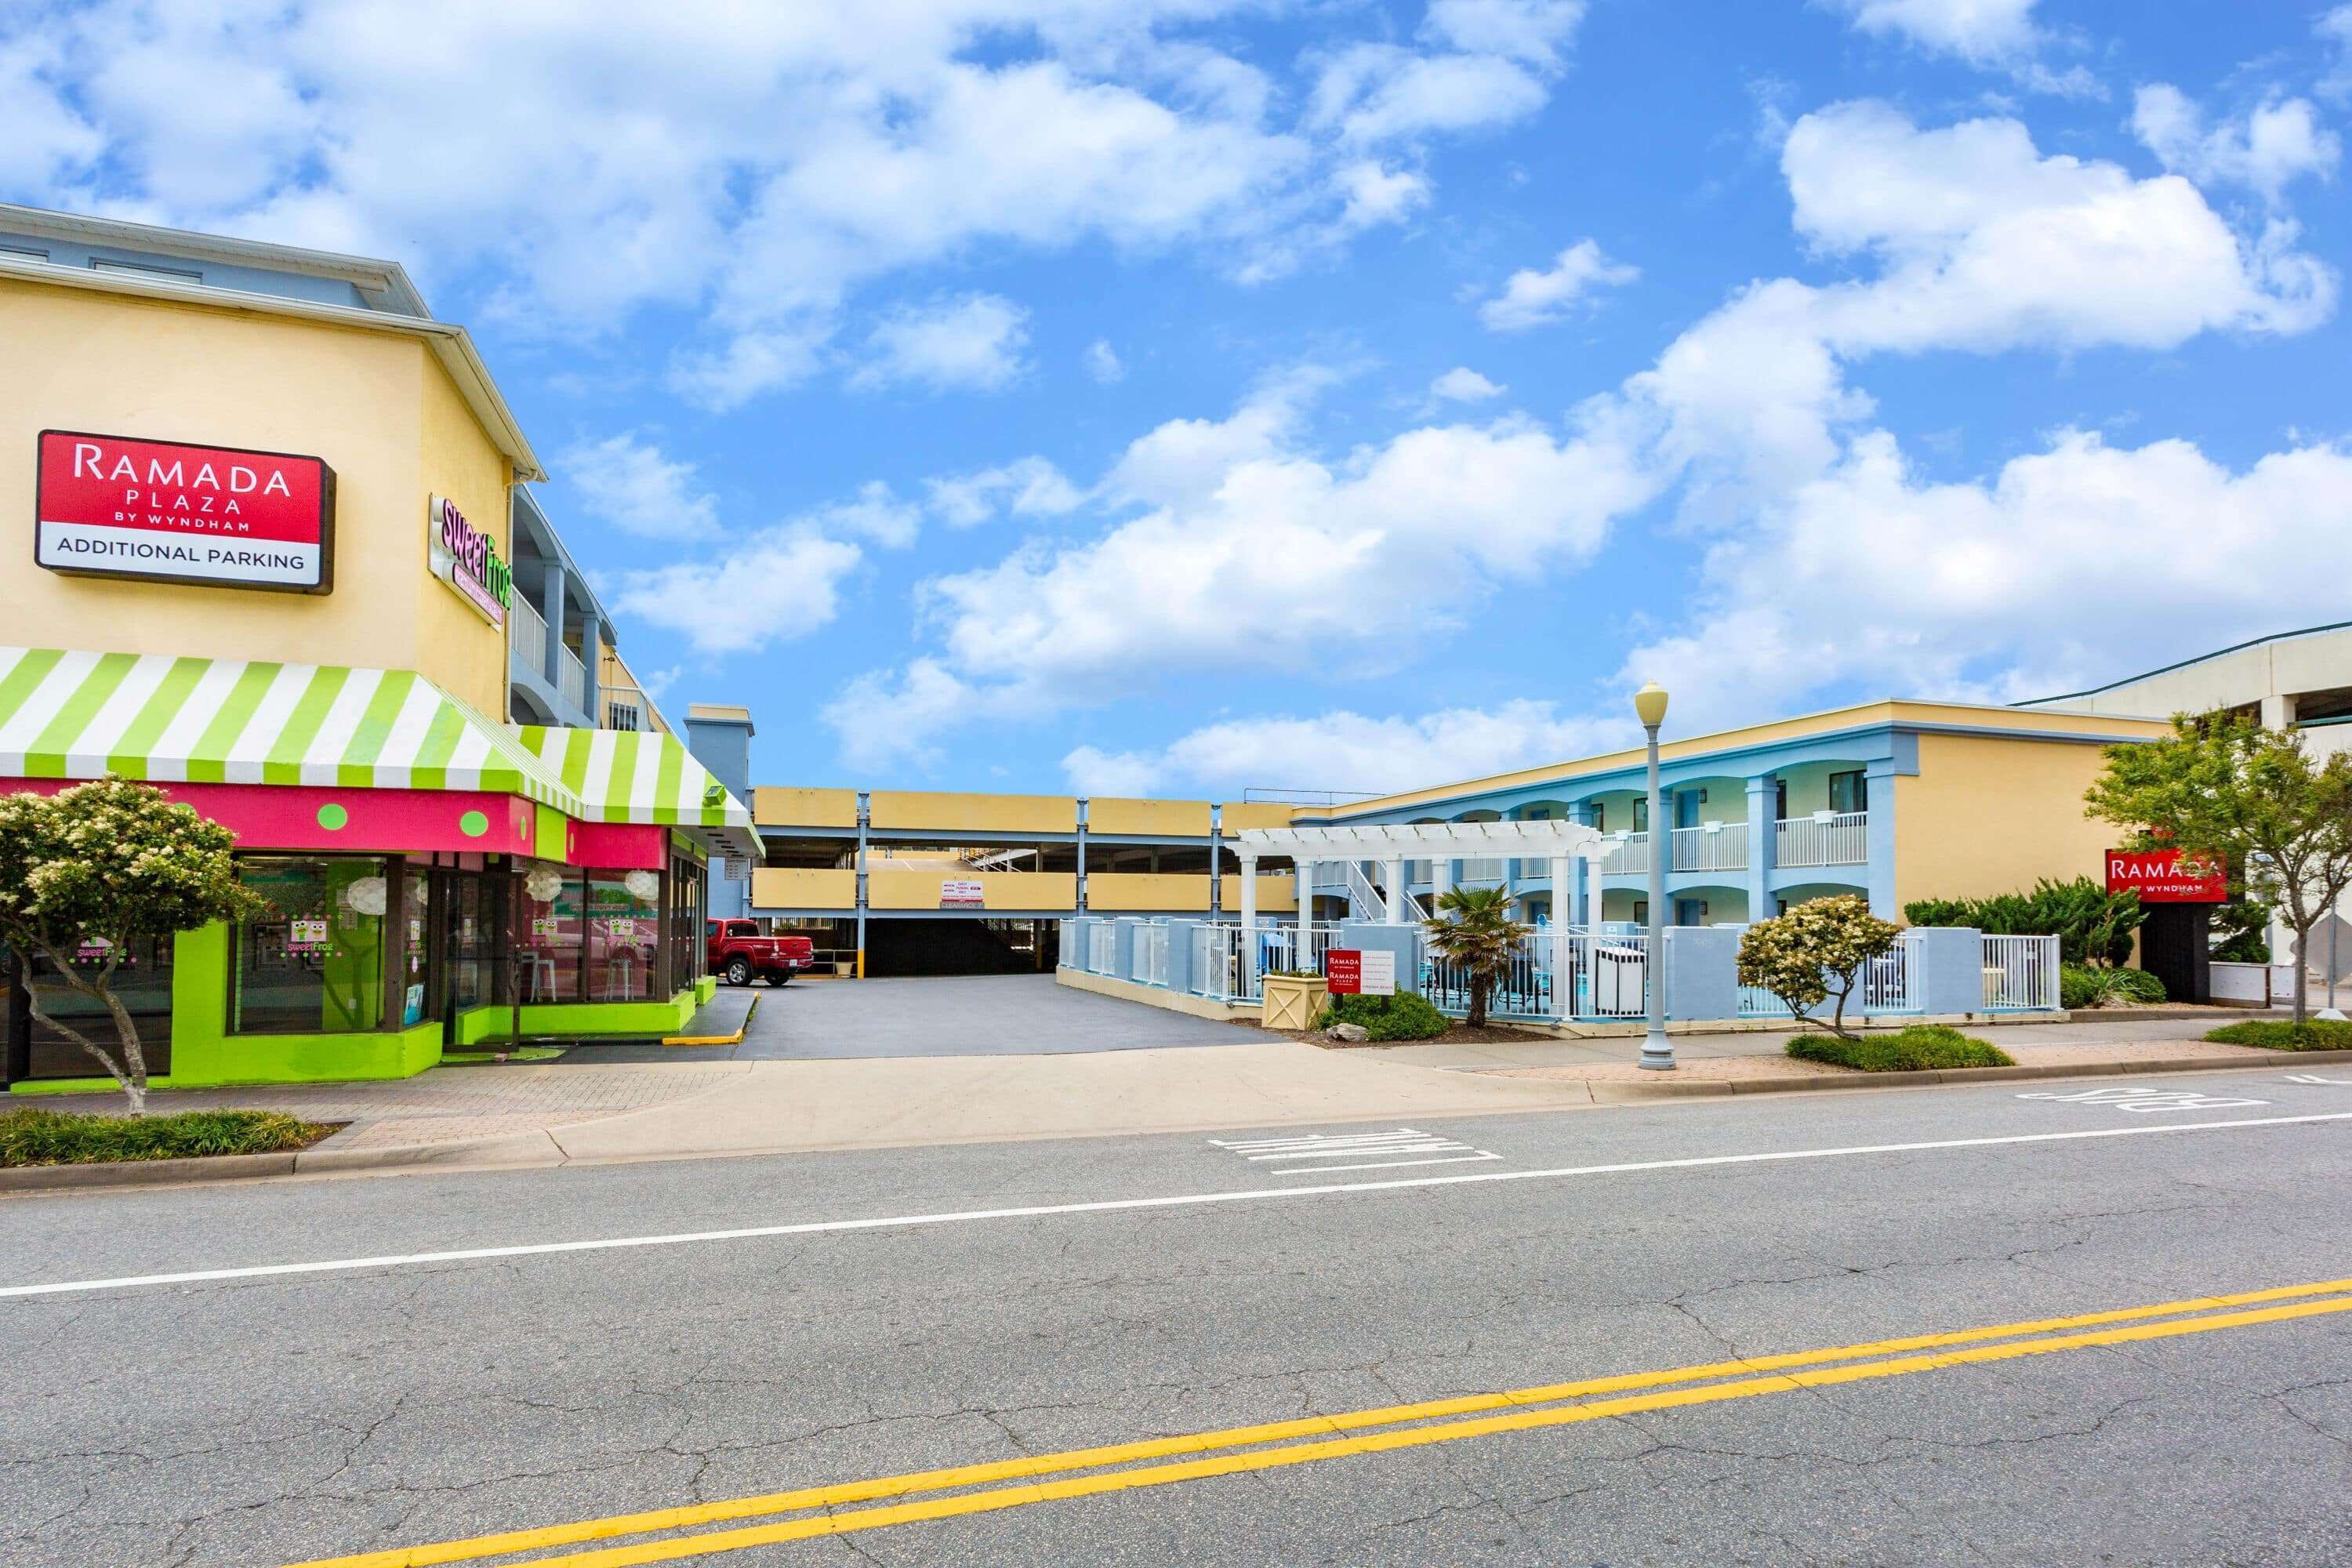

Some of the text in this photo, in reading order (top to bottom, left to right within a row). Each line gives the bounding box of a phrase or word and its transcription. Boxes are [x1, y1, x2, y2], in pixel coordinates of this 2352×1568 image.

[74, 443, 291, 498] RAMADA
[126, 489, 241, 514] PLAZA
[114, 511, 250, 532] BY WYNDHAM
[57, 537, 304, 570] ADDITIONAL PARKING
